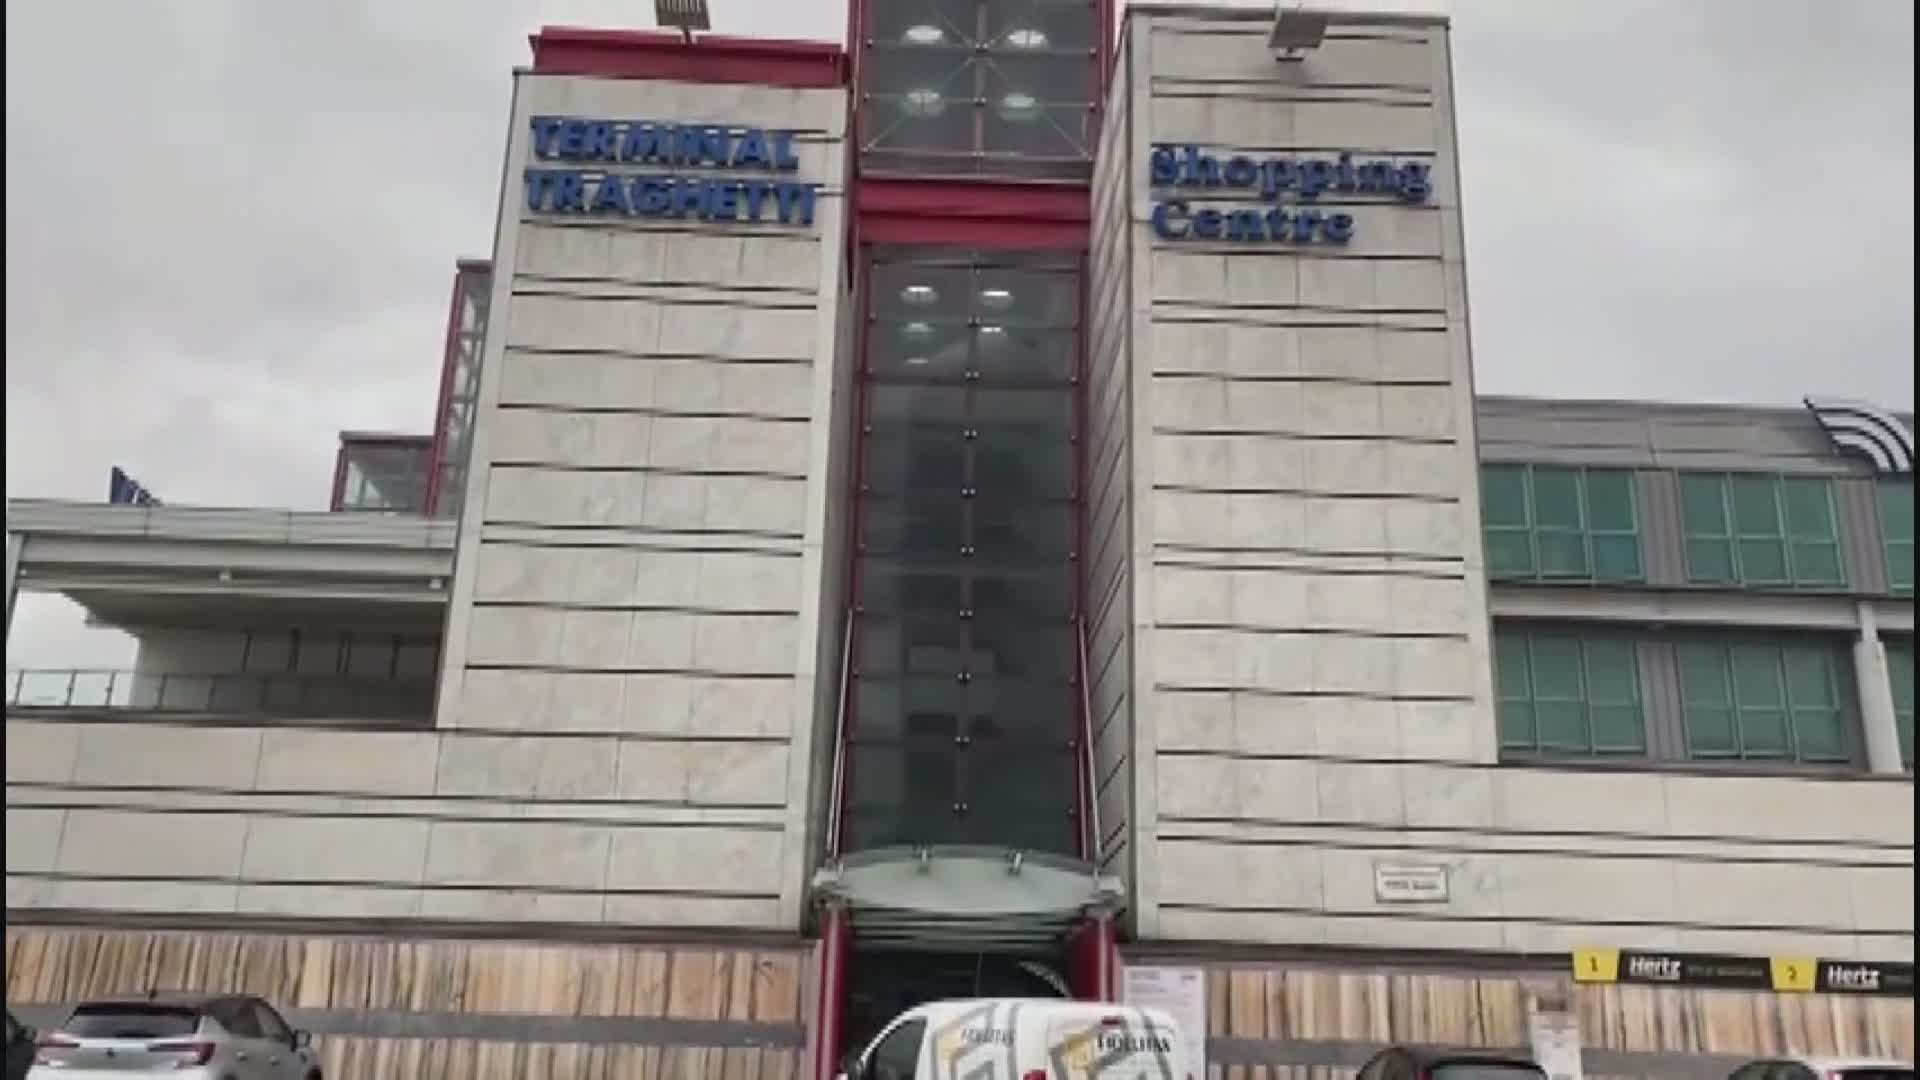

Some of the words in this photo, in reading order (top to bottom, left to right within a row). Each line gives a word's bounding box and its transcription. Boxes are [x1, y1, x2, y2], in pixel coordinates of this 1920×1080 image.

[530, 116, 798, 172] TERMINAL
[525, 170, 816, 225] TRAGHETTI
[1151, 145, 1431, 201] Shopping
[1152, 200, 1354, 245] Centre
[1630, 956, 1680, 979] Hertz
[1827, 965, 1880, 989] Hertz
